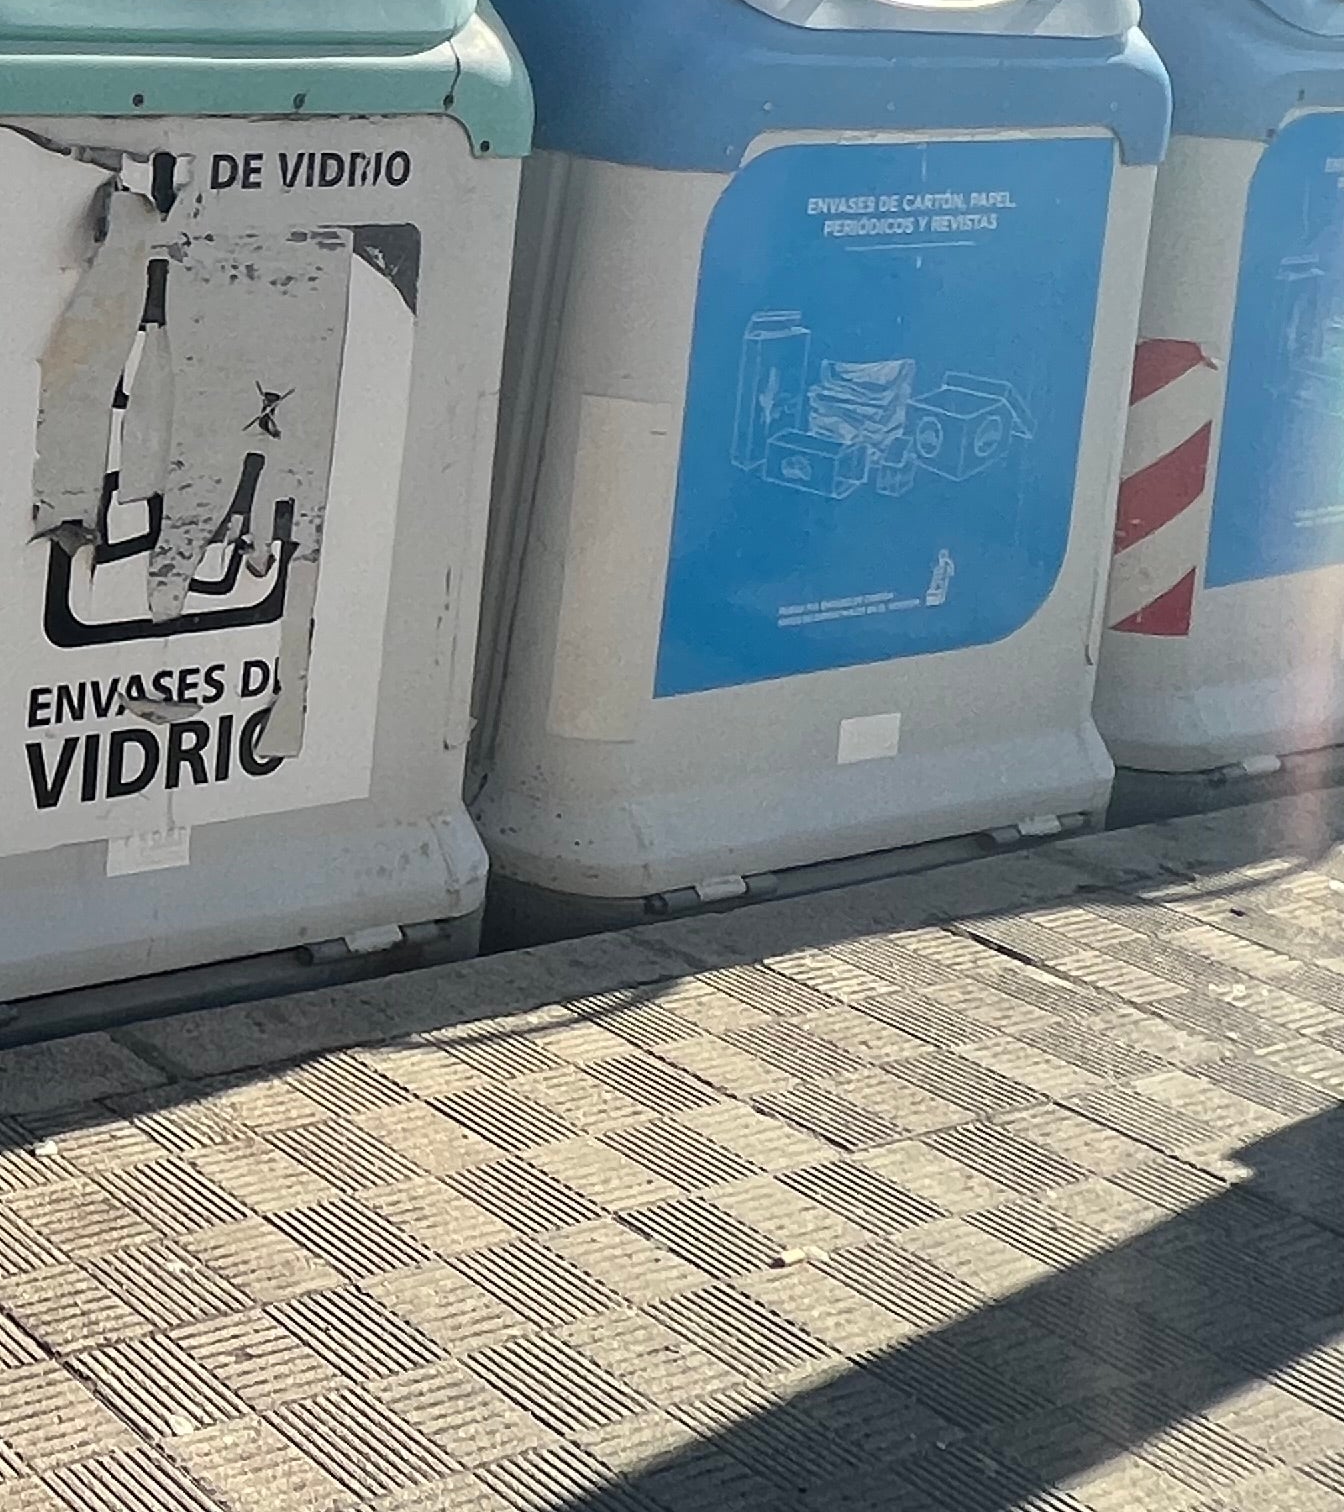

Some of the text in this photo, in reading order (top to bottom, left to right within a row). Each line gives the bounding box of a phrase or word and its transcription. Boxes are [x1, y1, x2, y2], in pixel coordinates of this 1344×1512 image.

[210, 150, 411, 190] DE VIDRIO
[806, 196, 875, 215] ENVASES
[878, 194, 900, 212] DE
[823, 213, 998, 237] PERIÓDICOS Y REVISTAS
[28, 663, 225, 728] ENVASES
